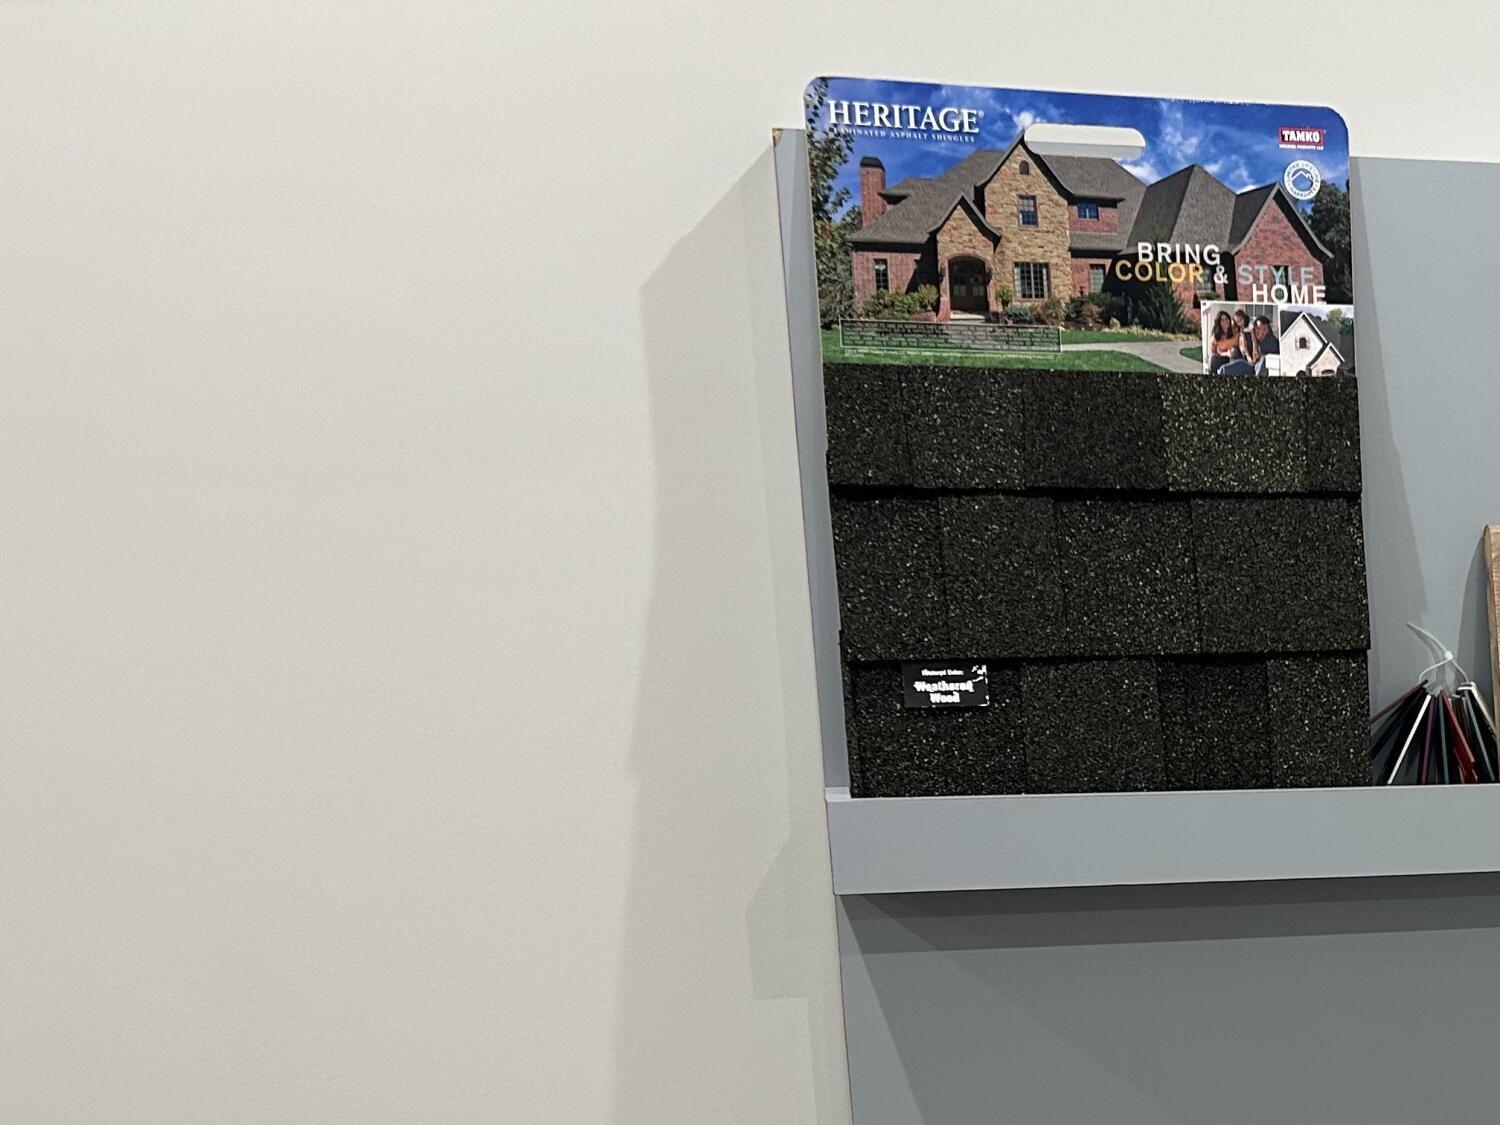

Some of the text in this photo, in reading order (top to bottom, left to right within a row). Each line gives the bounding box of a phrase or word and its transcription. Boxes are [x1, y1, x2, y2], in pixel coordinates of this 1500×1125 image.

[827, 100, 980, 134] HERITAGE
[890, 131, 928, 141] ASPHALT
[932, 134, 975, 143] SHINGLES
[1282, 130, 1320, 143] TAMKO
[1137, 242, 1220, 265] BRING
[1115, 260, 1314, 286] COLOR & STYLE
[1252, 283, 1327, 305] HOME
[929, 691, 961, 703] Wood
